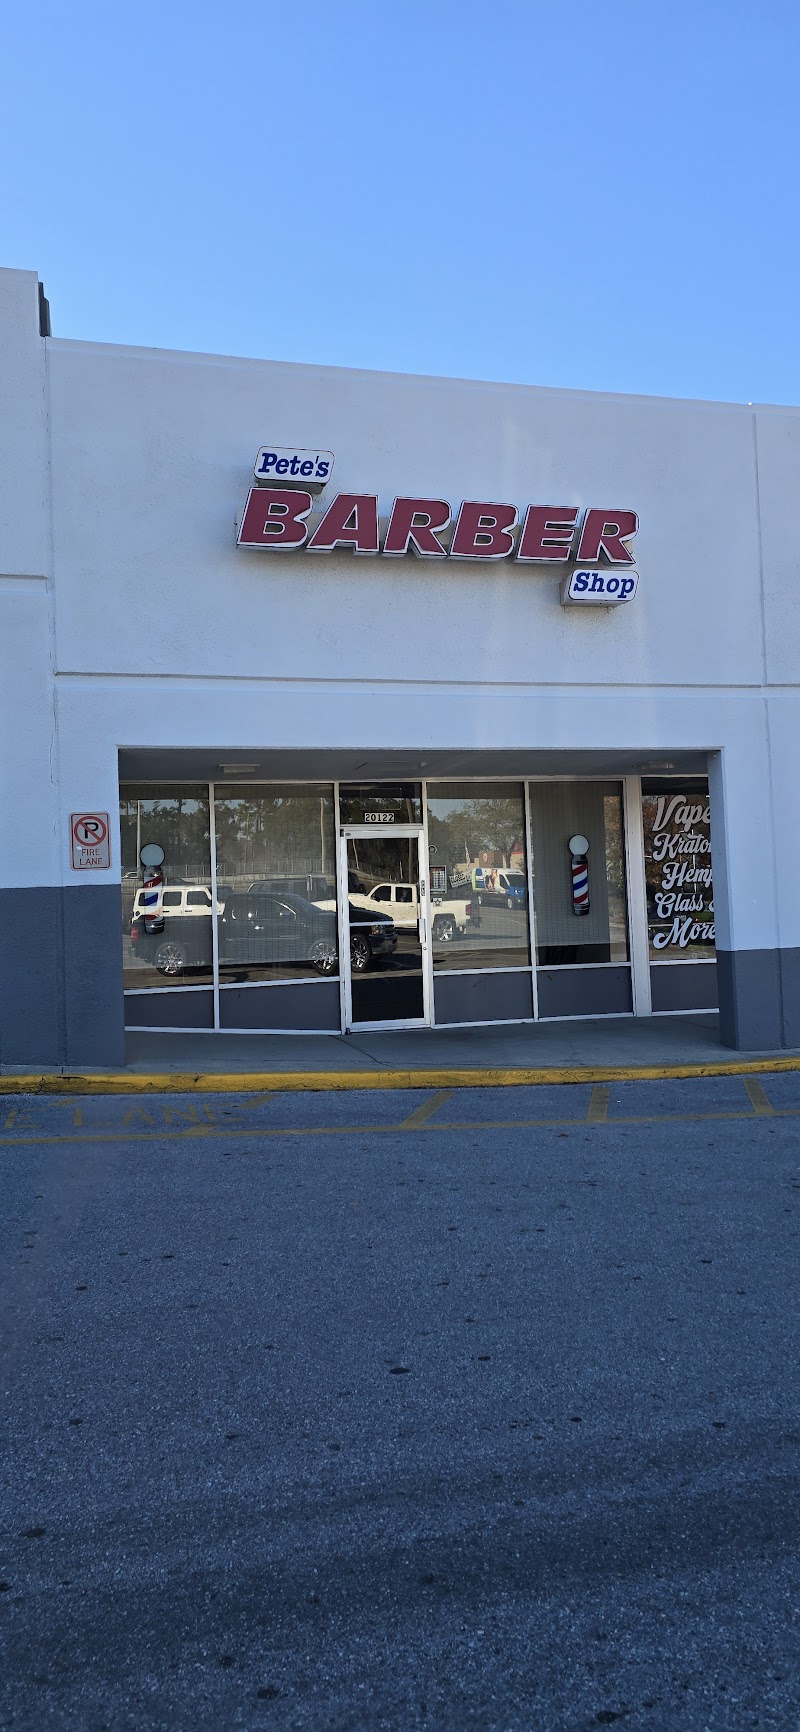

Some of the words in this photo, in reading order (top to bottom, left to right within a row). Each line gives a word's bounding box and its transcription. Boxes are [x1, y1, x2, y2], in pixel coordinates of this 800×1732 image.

[257, 452, 330, 478] Pete's
[237, 487, 640, 564] BARBER
[573, 571, 635, 599] Shop
[365, 813, 394, 822] 20122
[652, 795, 711, 832] Vape
[79, 857, 103, 866] LANE
[81, 848, 101, 856] FIRE
[654, 892, 704, 919] Glass
[652, 917, 716, 949] More
